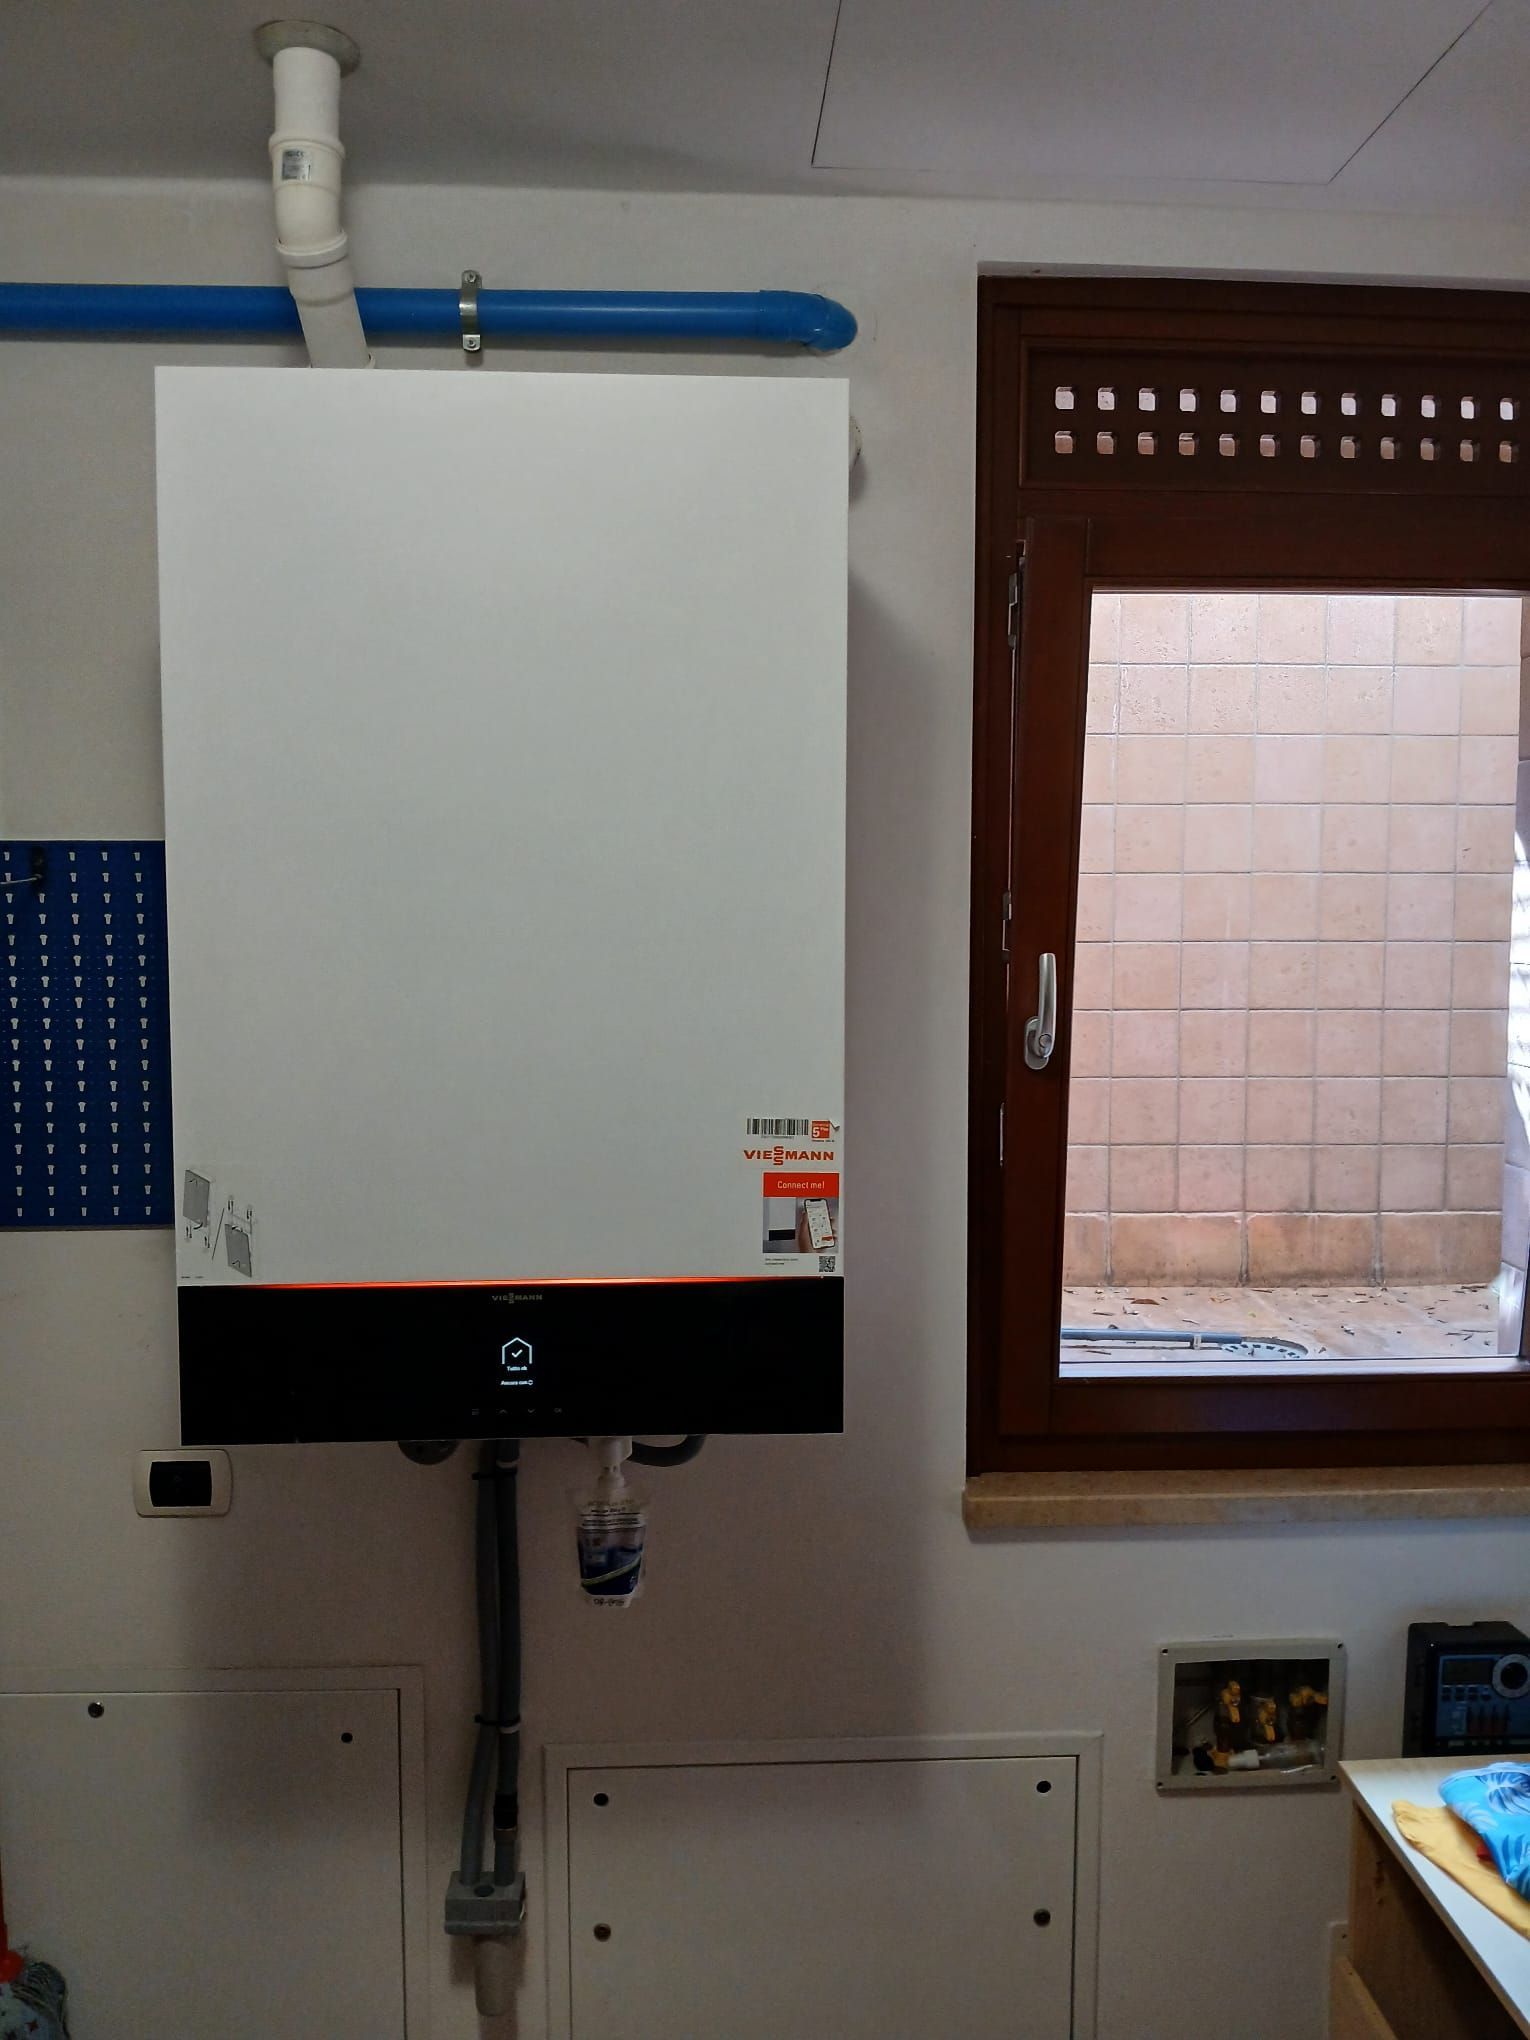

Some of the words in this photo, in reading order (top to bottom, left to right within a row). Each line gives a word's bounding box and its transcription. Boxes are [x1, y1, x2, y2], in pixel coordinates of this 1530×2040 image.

[812, 1127, 820, 1138] 5
[743, 1146, 834, 1166] VIESSMANN
[777, 1180, 809, 1189] Connect
[810, 1180, 825, 1189] me!
